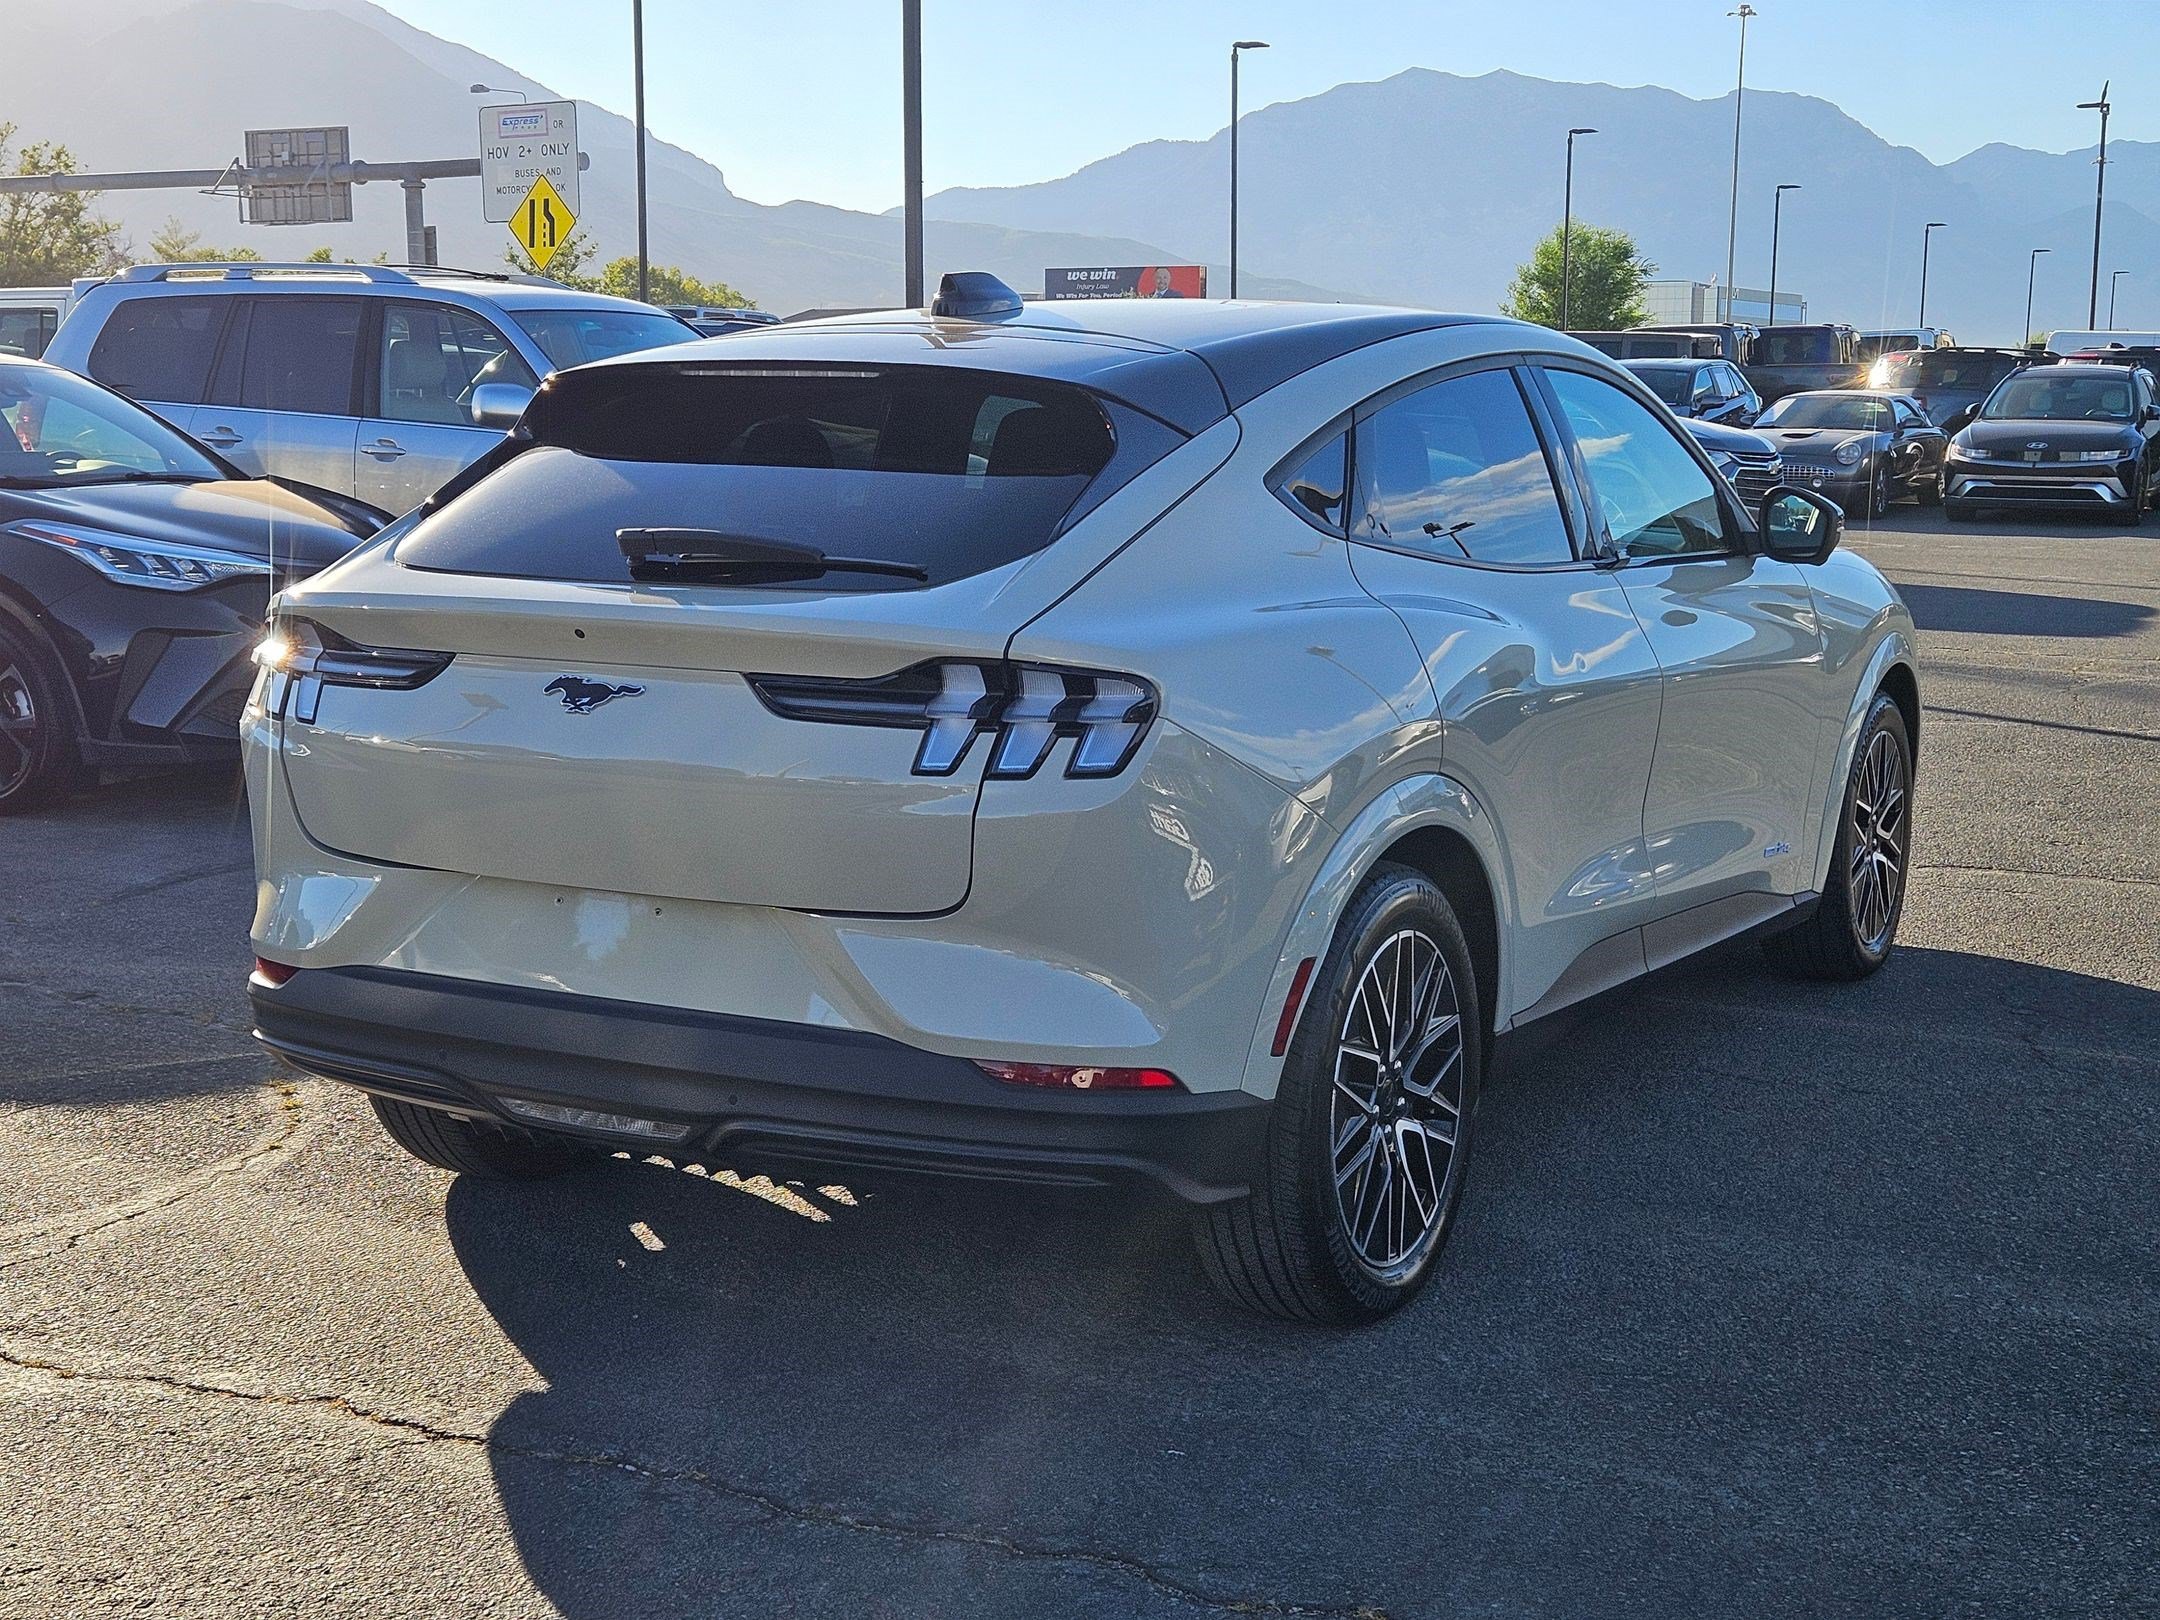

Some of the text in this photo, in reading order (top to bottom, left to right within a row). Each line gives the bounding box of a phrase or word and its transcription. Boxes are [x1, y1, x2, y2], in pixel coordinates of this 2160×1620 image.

[502, 117, 539, 130] Express
[553, 120, 564, 128] OR
[487, 143, 570, 159] HOV 2+ ONLY
[515, 167, 562, 178] BUSES AND
[496, 183, 566, 195] MOTORCY OK
[1067, 271, 1088, 281] we
